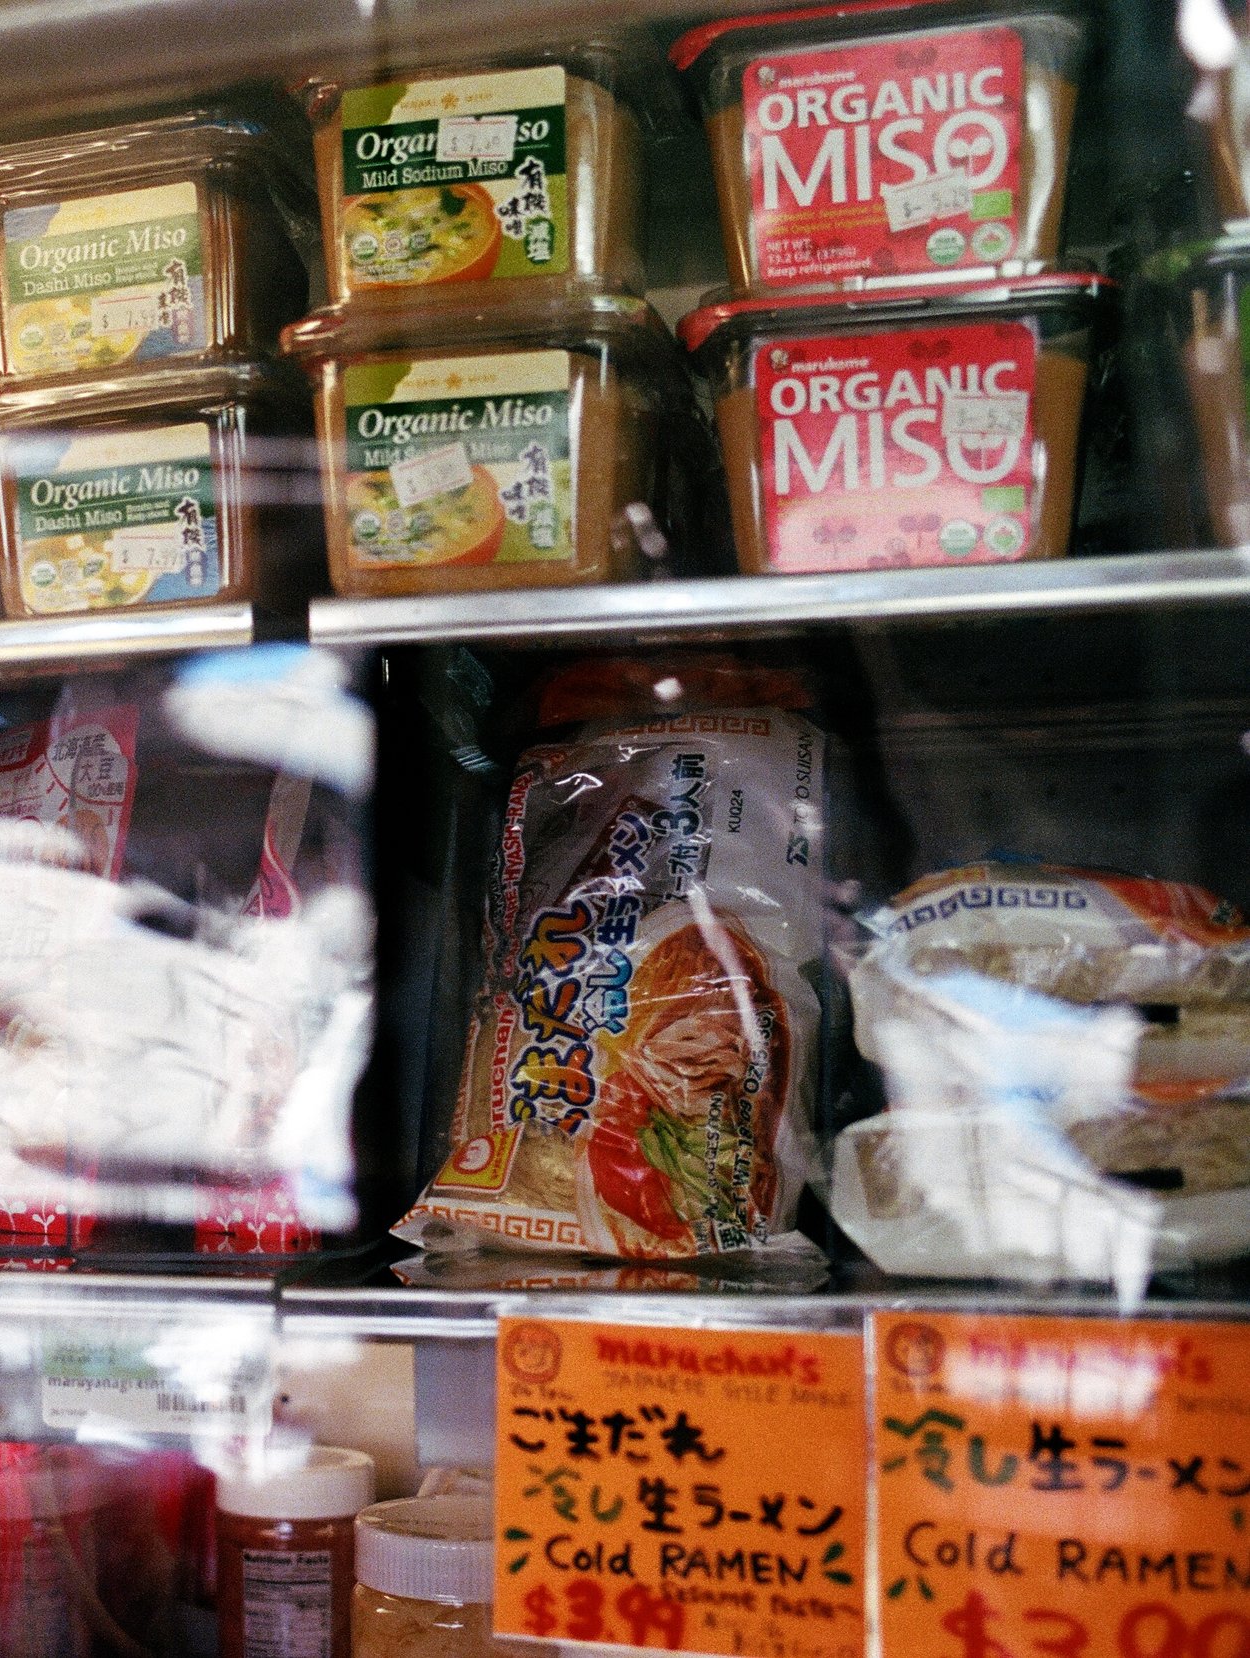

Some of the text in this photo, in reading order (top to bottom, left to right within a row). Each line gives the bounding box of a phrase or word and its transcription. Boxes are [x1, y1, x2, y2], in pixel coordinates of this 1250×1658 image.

[757, 67, 1004, 131] ORGANIC
[362, 160, 509, 189] Mild Sodium Miso
[760, 110, 1008, 210] MISO
[19, 235, 118, 274] Organic
[124, 226, 187, 256] Miso
[23, 278, 69, 297] Dashi
[72, 271, 112, 290] Miso
[791, 356, 870, 374] marukome
[769, 361, 1018, 416] ORGANIC
[358, 399, 553, 444] Organic Miso
[30, 473, 131, 511] Organic
[137, 466, 200, 493] Miso
[34, 513, 81, 533] Dashi
[85, 508, 123, 527] Miso
[78, 758, 113, 783] 大豆
[47, 1377, 133, 1394] maruyanagi
[543, 1534, 810, 1586] Cold RAMEN
[904, 1520, 1250, 1594] Cold RAMEN
[523, 1577, 686, 1652] $3.99
